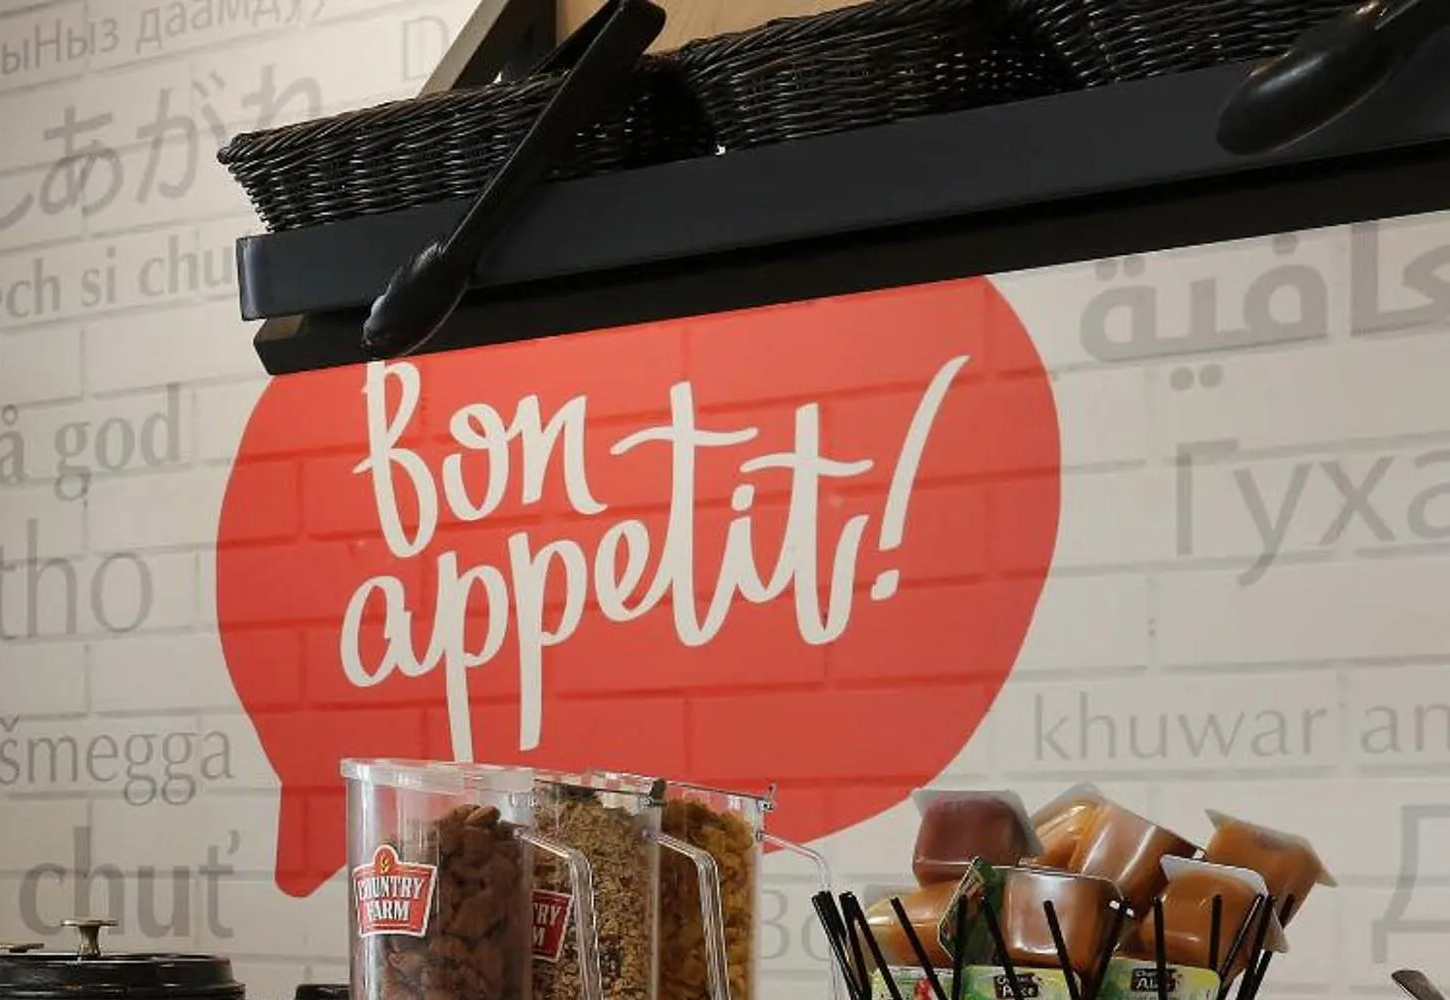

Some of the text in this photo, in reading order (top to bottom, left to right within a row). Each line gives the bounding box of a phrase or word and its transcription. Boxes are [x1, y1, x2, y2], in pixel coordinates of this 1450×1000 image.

[80, 247, 117, 307] si
[54, 384, 182, 500] god
[341, 355, 971, 765] appetit!
[1032, 691, 1328, 760] khuwar
[356, 875, 426, 900] COUNTRY
[364, 900, 411, 922] FARM
